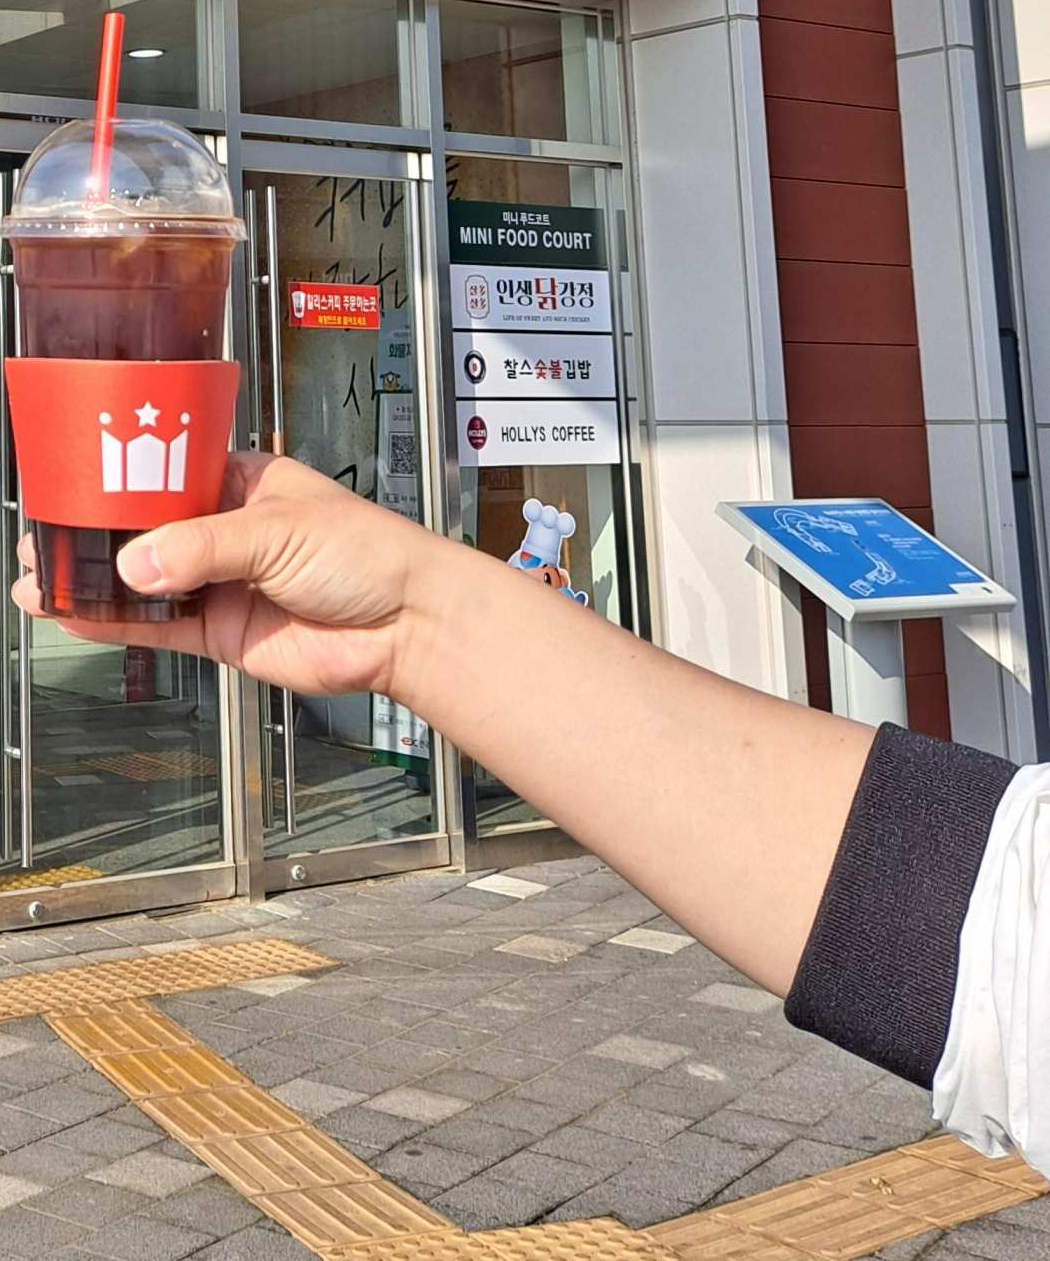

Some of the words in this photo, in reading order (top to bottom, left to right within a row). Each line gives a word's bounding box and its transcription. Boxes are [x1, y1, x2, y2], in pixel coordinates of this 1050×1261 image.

[459, 226, 492, 245] MINI
[497, 228, 538, 248] FOOD
[542, 230, 592, 250] COURT
[496, 277, 595, 310] 인생닭강정
[503, 358, 592, 380] 찰스숯불김밥
[501, 426, 546, 443] HOLLYS
[551, 425, 596, 442] COFFEE
